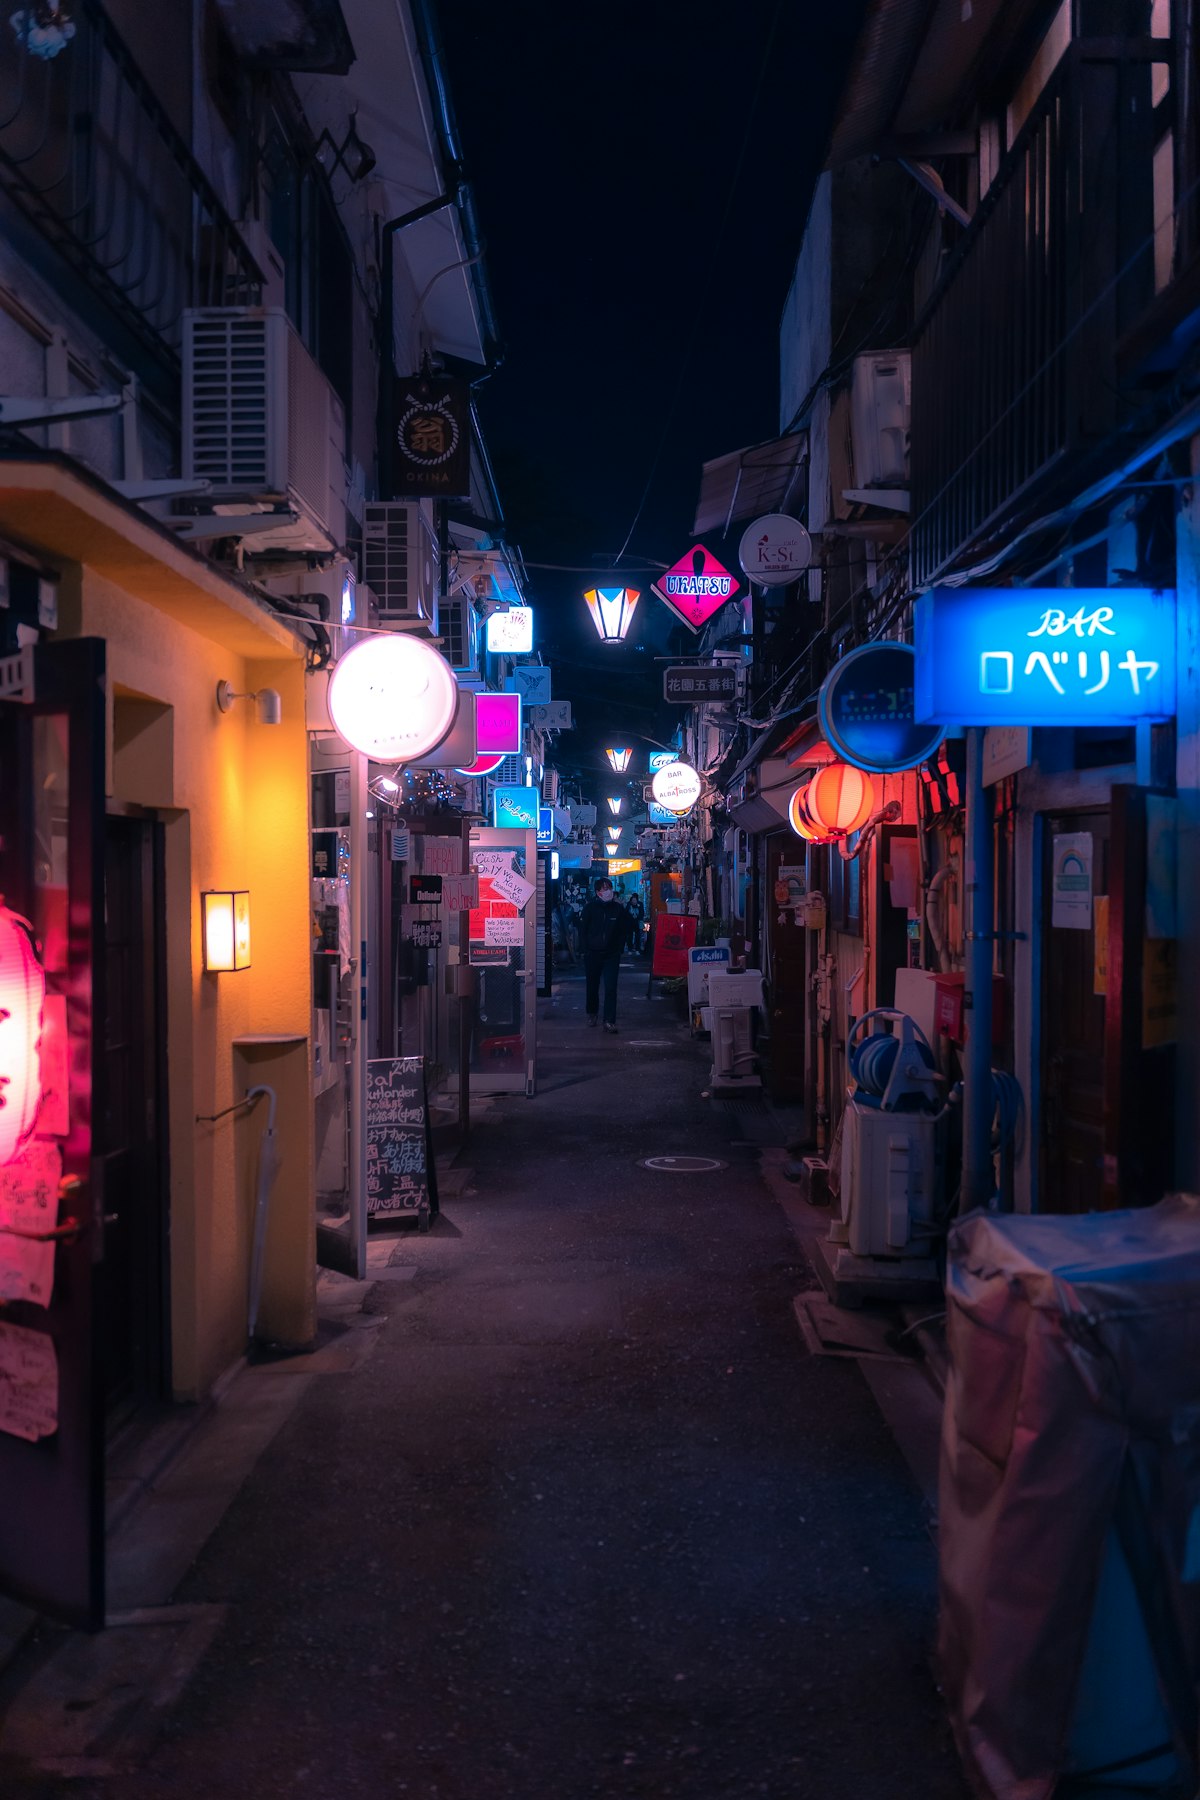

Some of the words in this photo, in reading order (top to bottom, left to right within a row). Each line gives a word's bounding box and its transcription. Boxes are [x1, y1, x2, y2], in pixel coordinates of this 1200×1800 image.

[410, 416, 445, 453] 翁
[406, 472, 449, 481] OKINA
[1027, 605, 1117, 637] BAR
[979, 649, 1159, 695] ロベリヤ
[667, 678, 735, 692] 花園五番街
[667, 771, 683, 779] BAR
[660, 786, 697, 798] ALBATROSS
[475, 853, 504, 864] Cash
[503, 869, 514, 880] We
[503, 878, 523, 895] Have
[696, 950, 723, 961] Asahi
